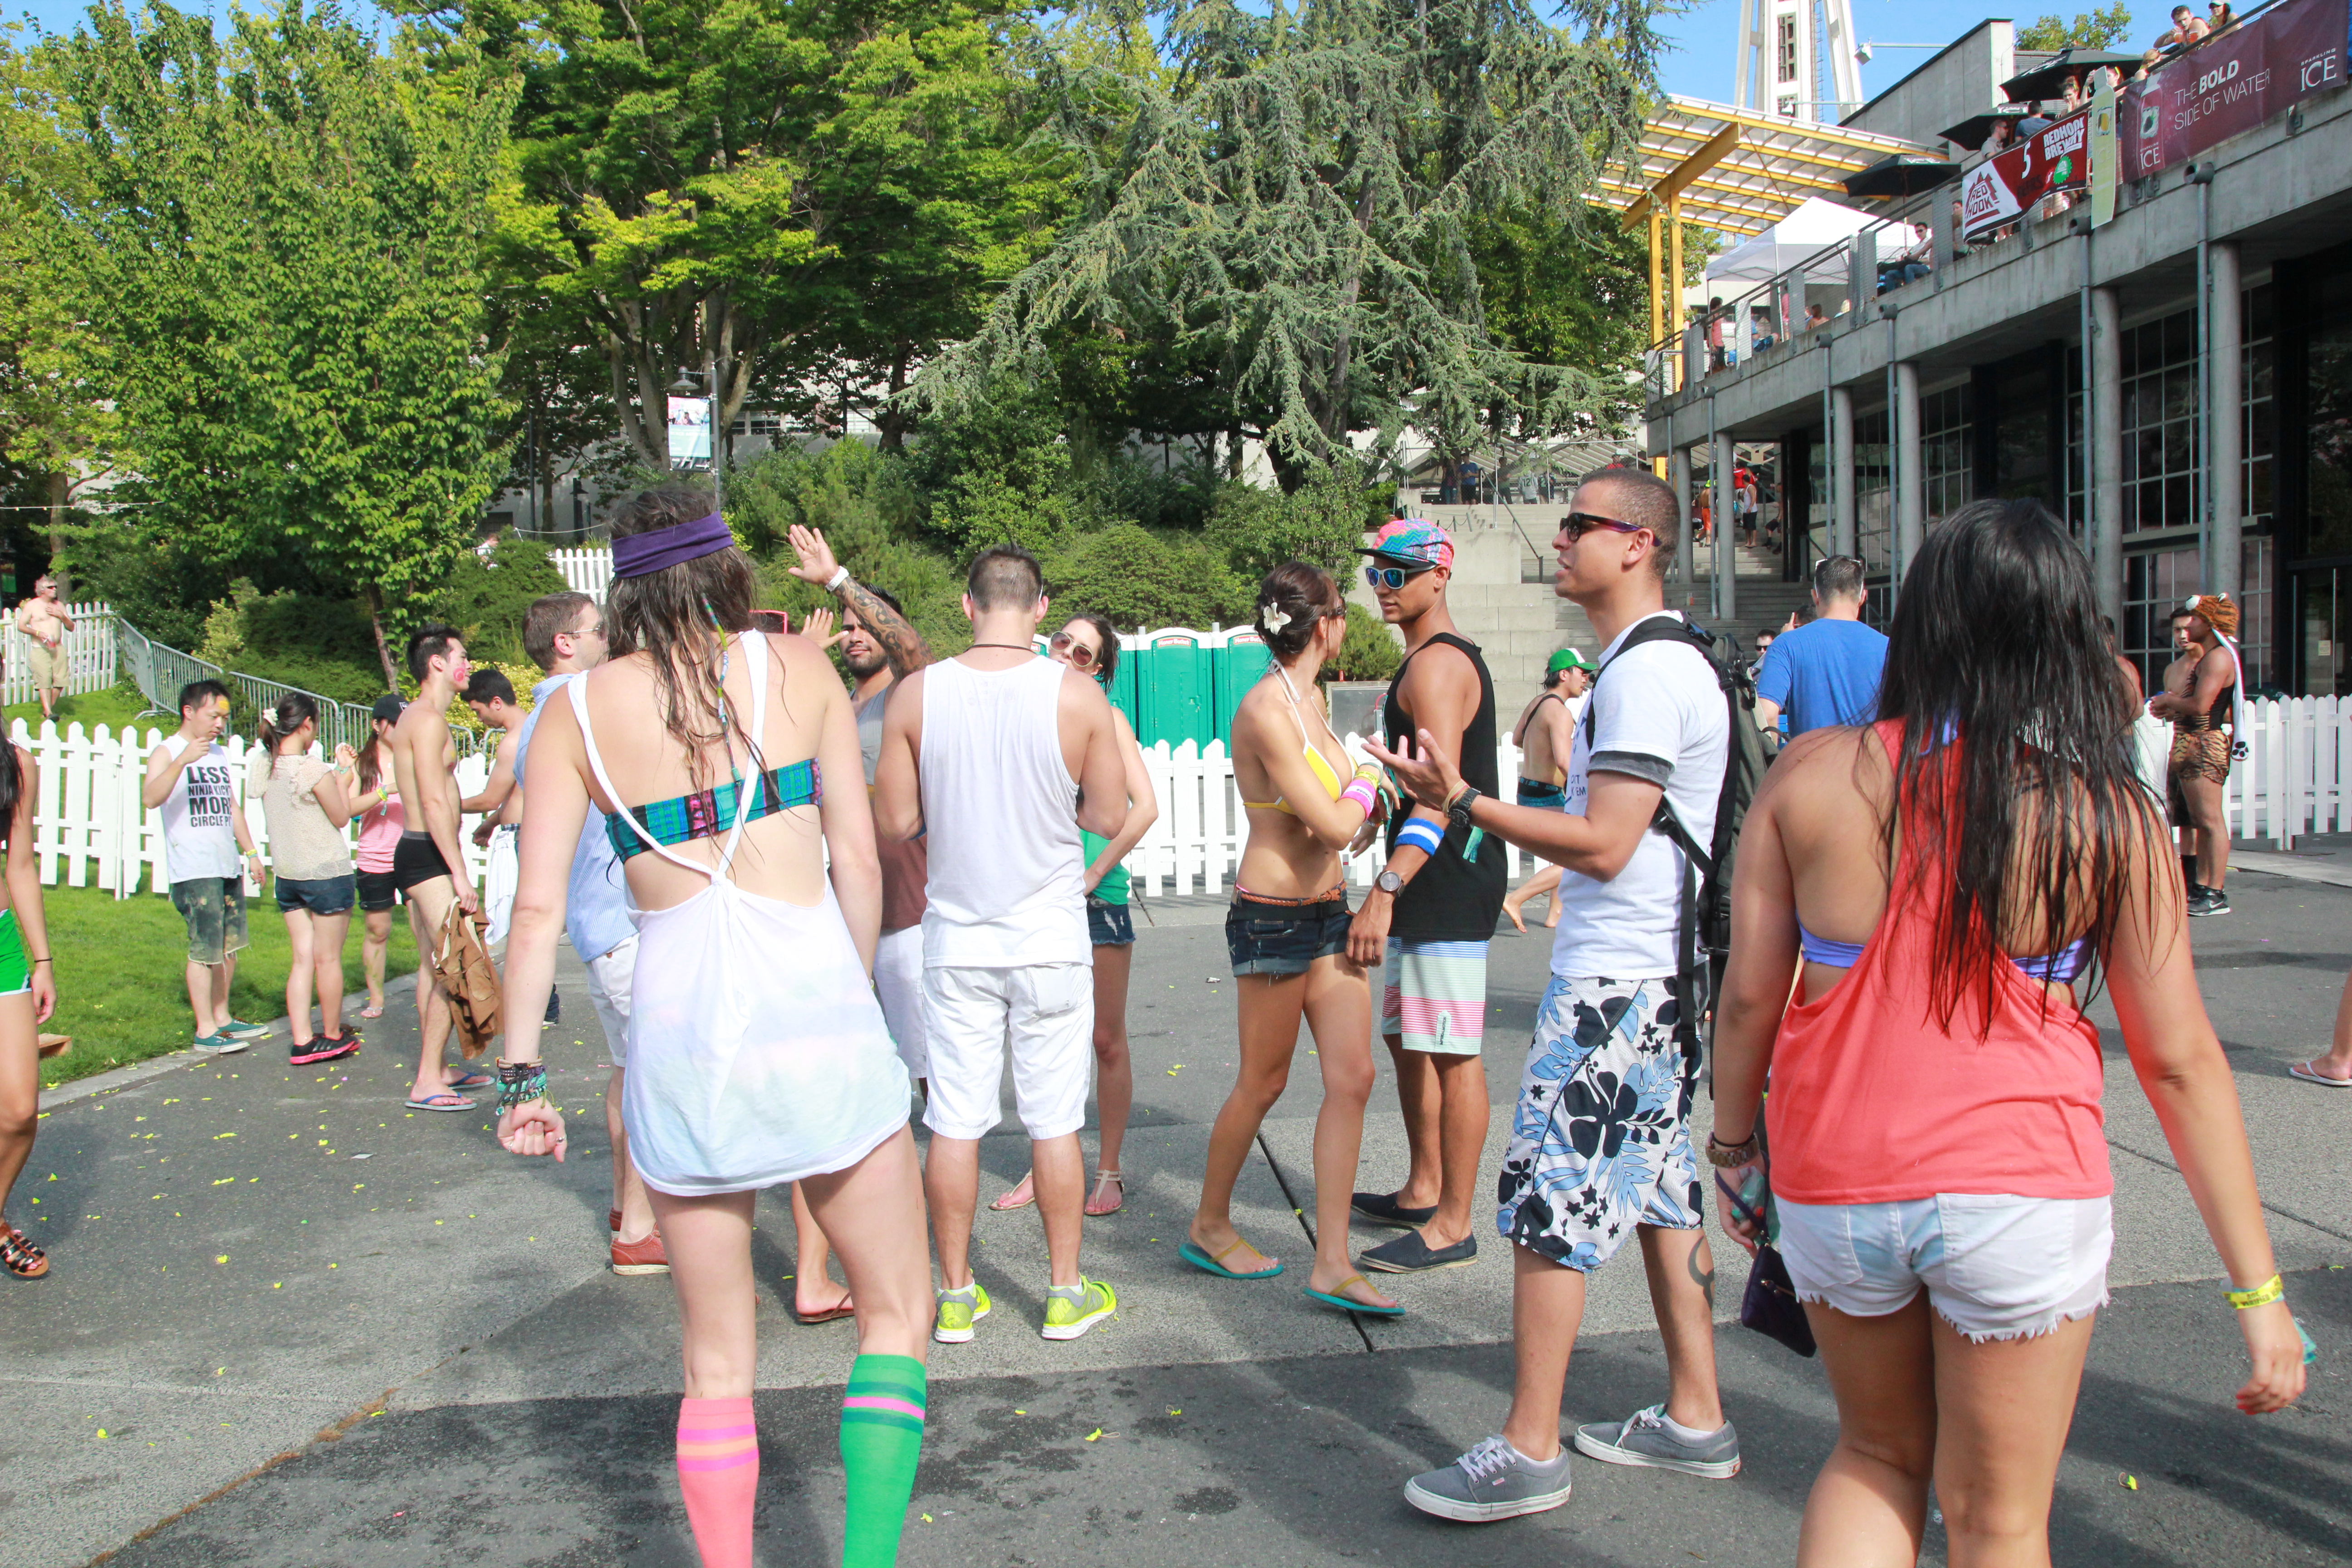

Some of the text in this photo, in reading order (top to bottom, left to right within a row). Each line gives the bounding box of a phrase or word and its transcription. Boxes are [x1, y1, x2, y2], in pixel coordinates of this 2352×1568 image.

[2300, 48, 2336, 66] SPARKLING
[2174, 59, 2240, 107] THE BOLD
[2300, 54, 2337, 92] ICE
[2174, 68, 2270, 130] SIDE OF WATER
[2022, 141, 2032, 179] 5
[2140, 147, 2161, 170] ICE
[1970, 185, 1988, 202] RED
[1966, 196, 1994, 219] HOOK
[186, 766, 230, 784] LESS
[188, 785, 213, 796] NINJA
[191, 815, 224, 827] CIRCLE
